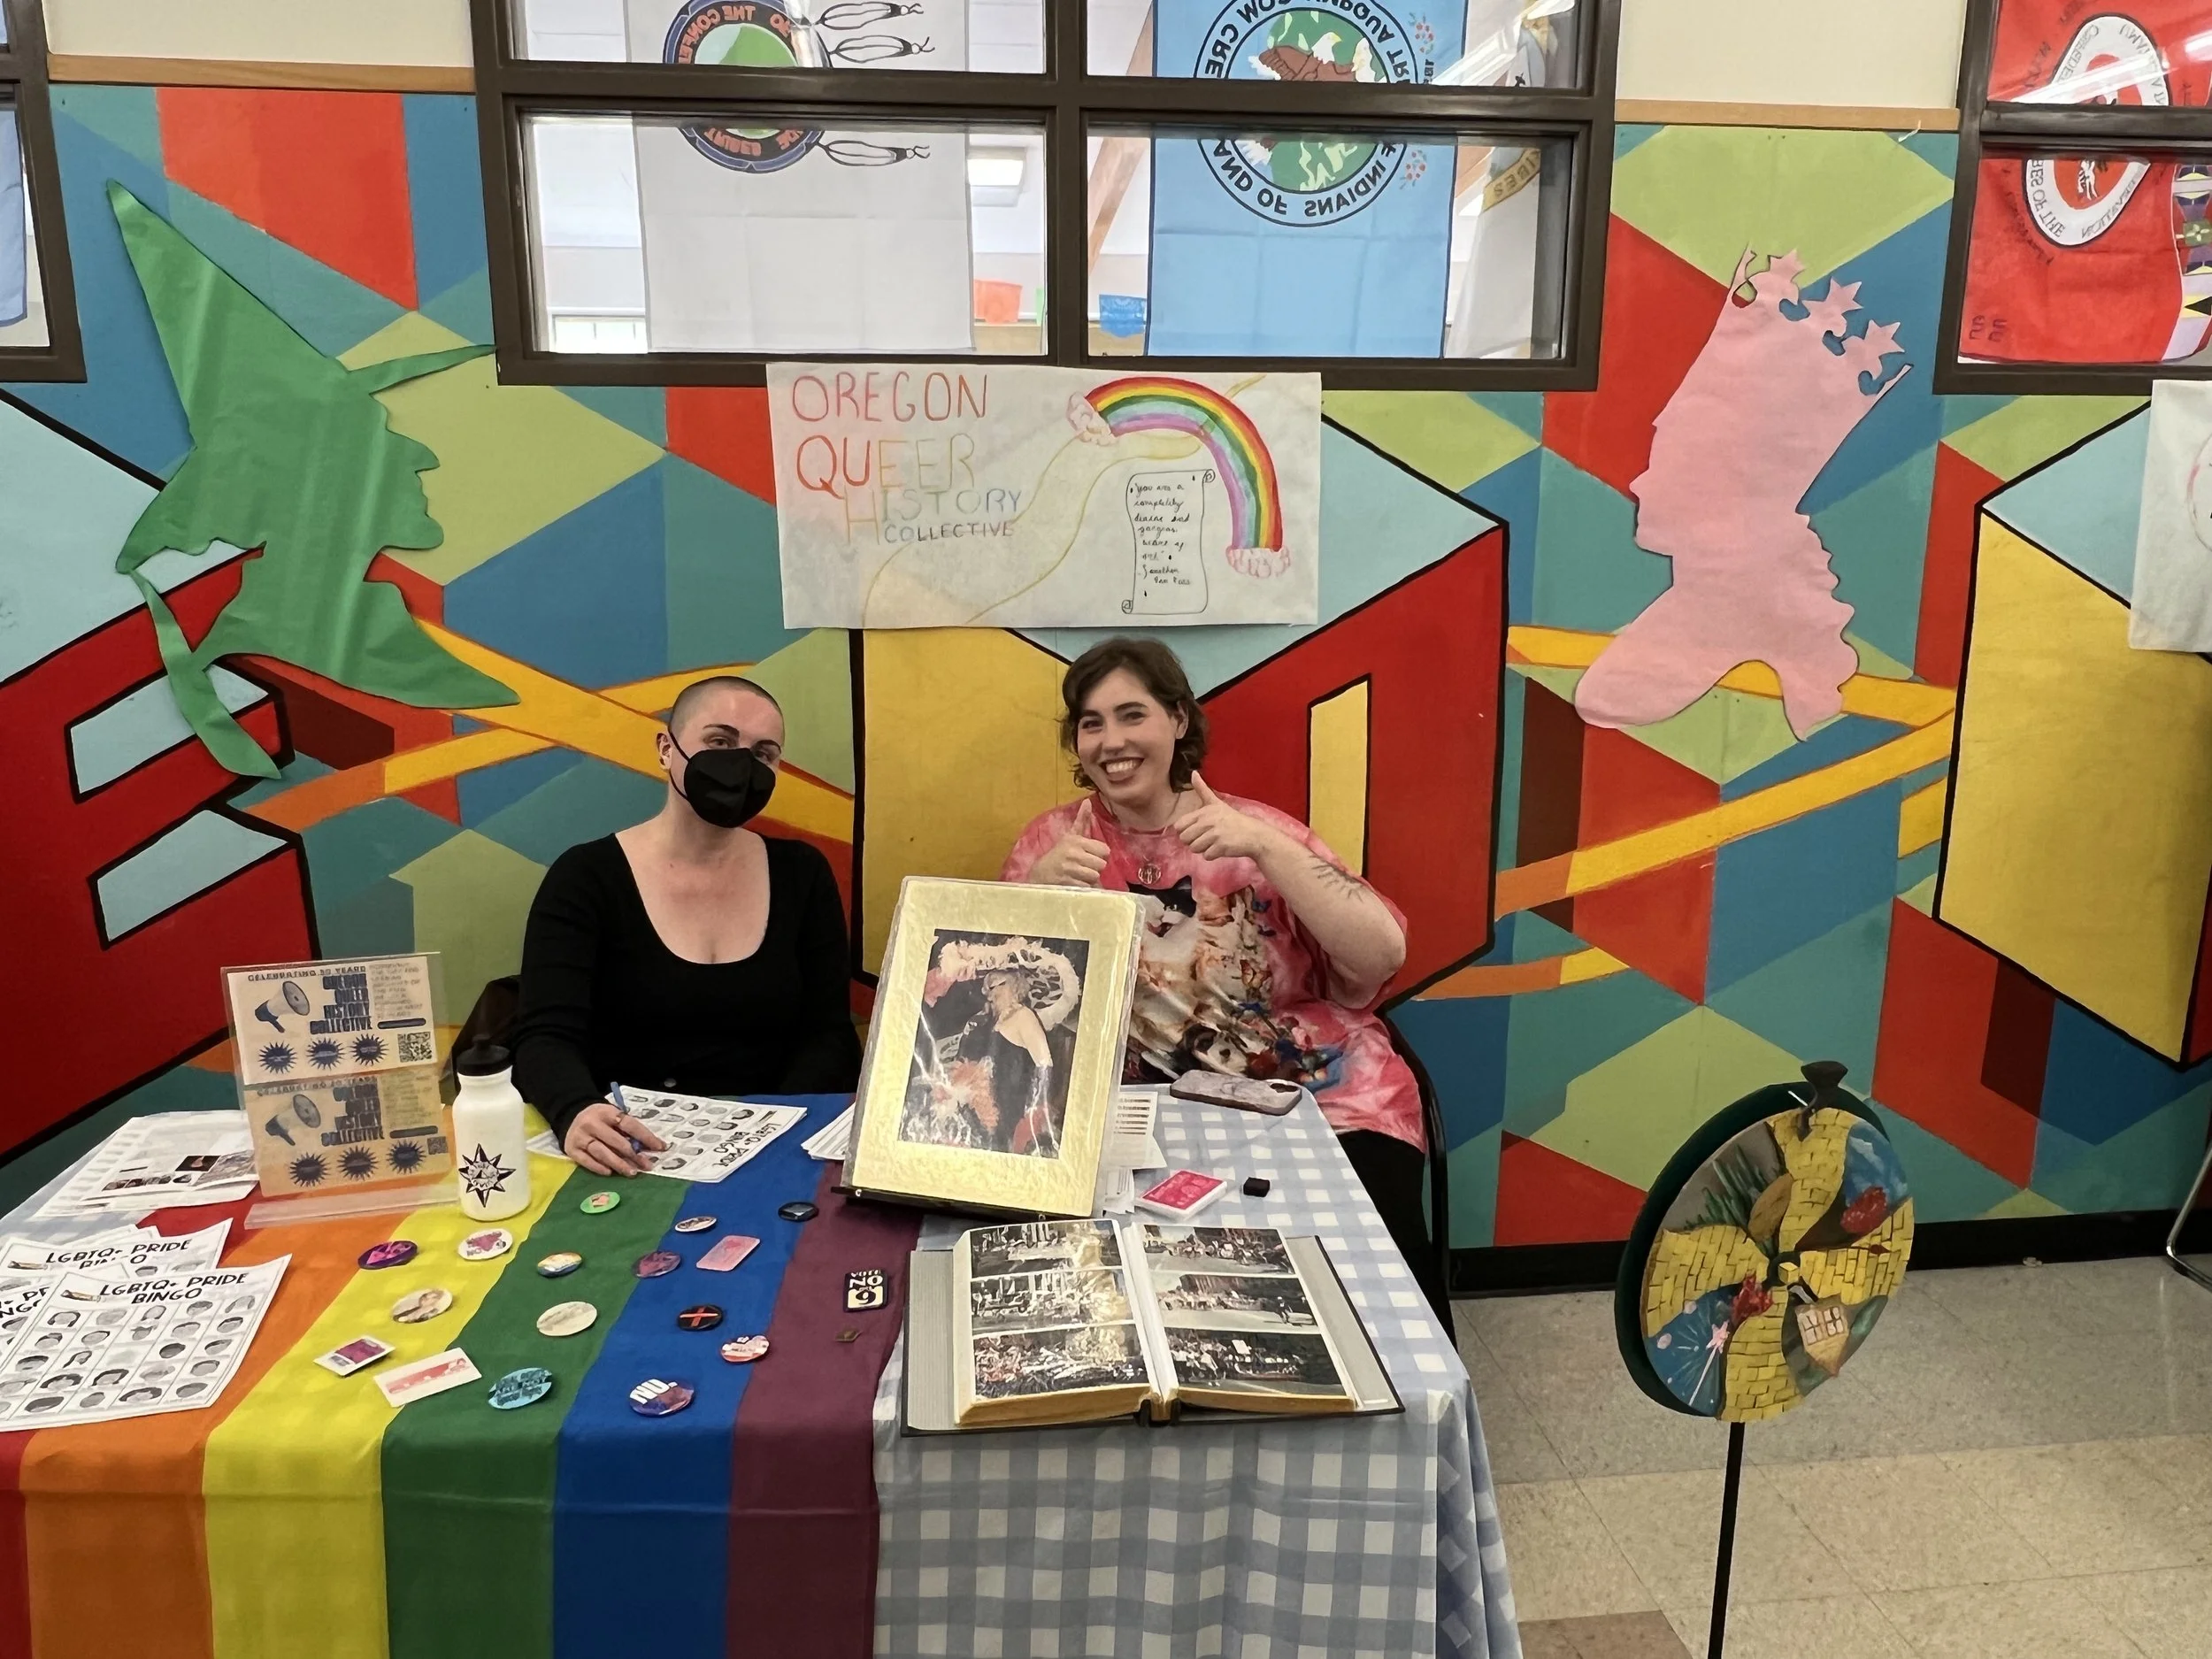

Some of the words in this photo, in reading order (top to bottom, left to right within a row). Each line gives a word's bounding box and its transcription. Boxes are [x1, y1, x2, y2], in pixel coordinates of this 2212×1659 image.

[793, 371, 987, 423] OREGON
[796, 433, 976, 500] QUEER
[843, 487, 1023, 545] HISTORY
[884, 521, 1016, 544] COLLECTIVE
[130, 1239, 193, 1256] PRIDE
[99, 1279, 177, 1297] LGBTQ+
[185, 1272, 250, 1289] PRIDE
[849, 1274, 883, 1288] NO
[131, 1286, 203, 1305] BINGO
[856, 1290, 876, 1305] 9
